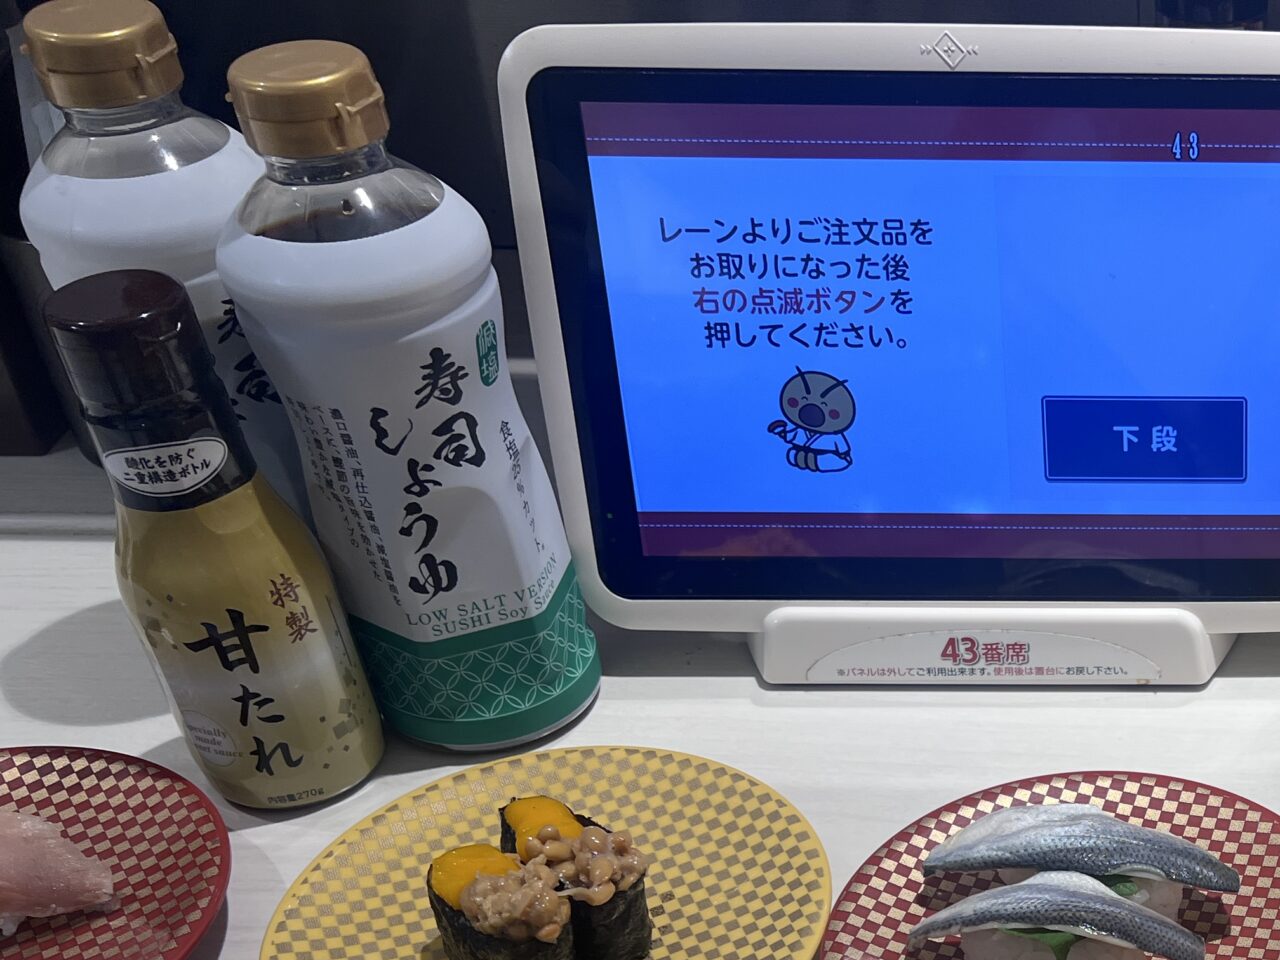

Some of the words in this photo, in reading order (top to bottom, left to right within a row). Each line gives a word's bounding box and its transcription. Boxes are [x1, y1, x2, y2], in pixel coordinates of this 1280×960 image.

[1172, 132, 1199, 159] 43
[659, 217, 933, 246] レーンよりご注文品を
[690, 252, 911, 282] お取りになった後
[692, 286, 913, 315] 右の点滅ボタンを
[703, 320, 907, 349] 押してください。
[477, 319, 499, 382] 減塩
[123, 458, 212, 485] 二重構造ボトル
[405, 608, 449, 626] LOW
[457, 594, 507, 617] SALT
[513, 552, 558, 602] VERSION
[269, 573, 318, 644] 特製
[431, 610, 493, 638] SUSHI
[498, 605, 529, 621] Soy
[940, 637, 1030, 666] 43番席
[183, 608, 304, 776] 甘たれ
